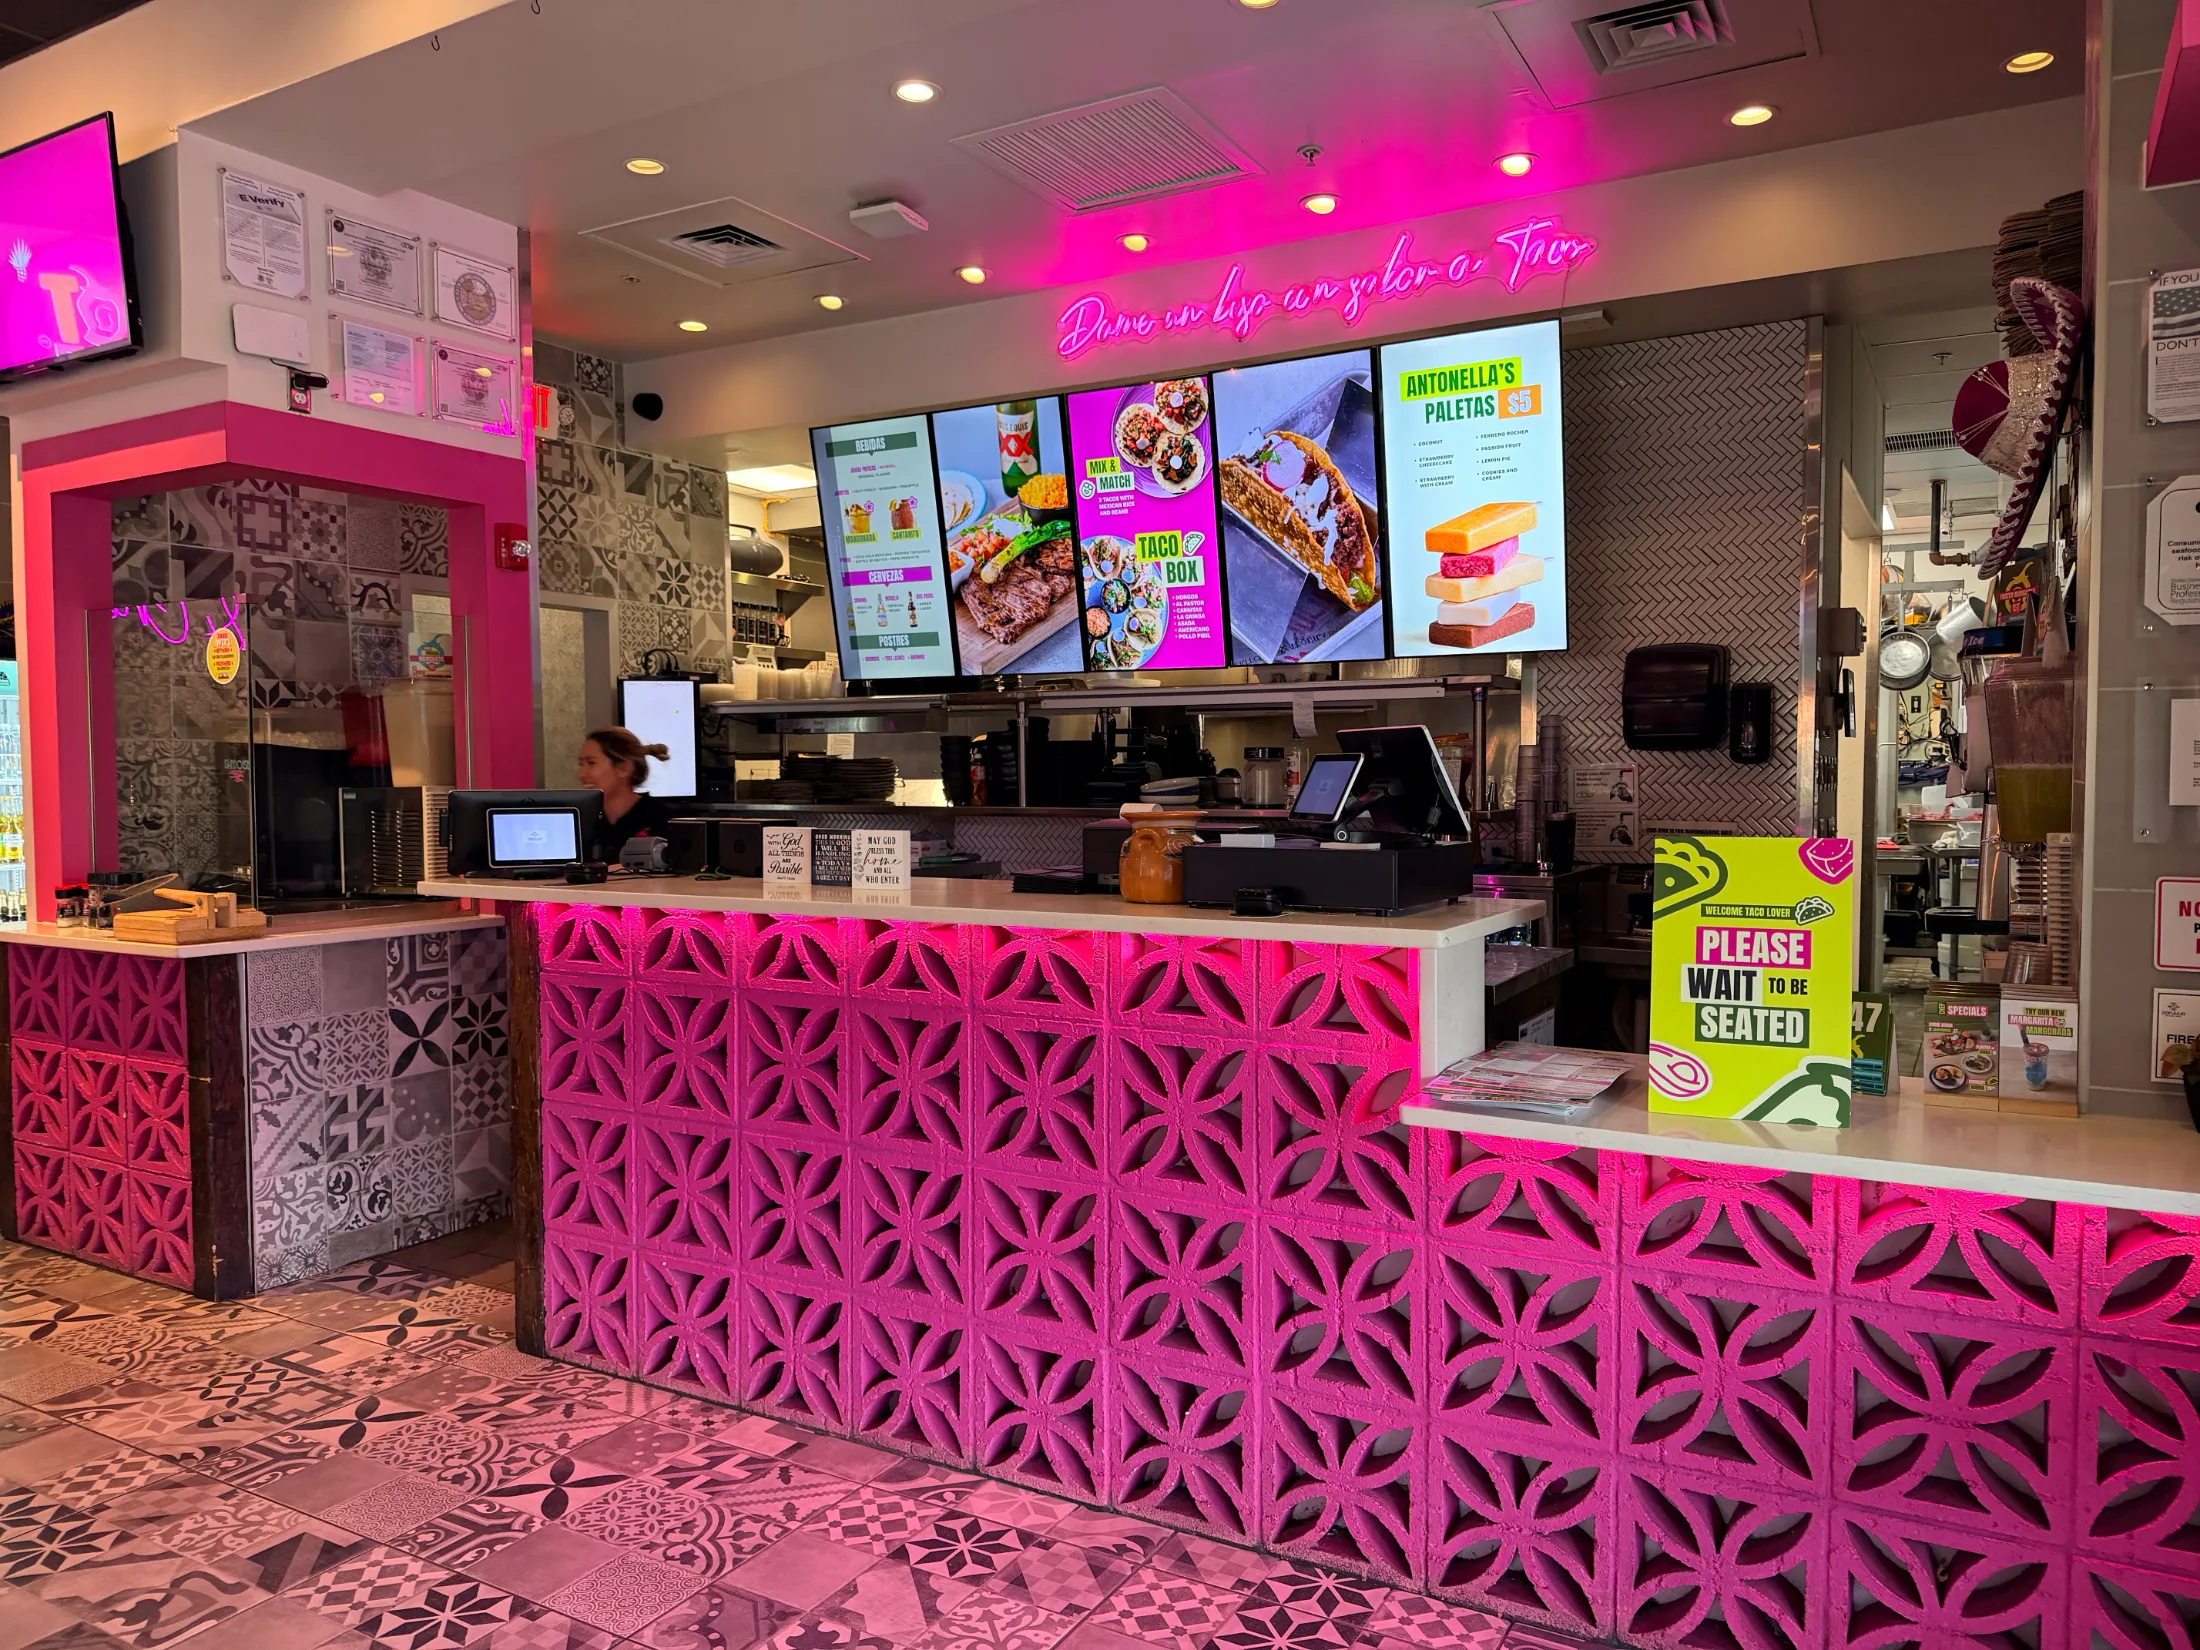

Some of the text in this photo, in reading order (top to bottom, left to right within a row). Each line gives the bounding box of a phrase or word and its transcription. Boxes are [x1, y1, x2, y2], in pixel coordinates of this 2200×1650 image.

[2158, 272, 2200, 287] IF YOU
[1406, 361, 1515, 398] ANTONELLA'S
[1425, 389, 1532, 424] PALETAS $5
[1010, 421, 1029, 432] EQUIS
[855, 437, 886, 452] BEBIDAS
[1418, 439, 1443, 447] COCONUT
[1480, 444, 1504, 452] PASSION
[1418, 454, 1454, 463] STRAWBERRY
[1418, 460, 1453, 468] CHEESECAKE
[1089, 459, 1117, 475] MIX &
[1099, 474, 1131, 491] MATCH
[1419, 475, 1455, 483] STRAWBERRY
[845, 530, 919, 543] MANGONADA CANTARITO
[1138, 534, 1179, 558] TACO
[868, 569, 904, 583] CERVEZAS
[1166, 560, 1198, 583] BOX
[879, 634, 910, 647] POSTRES
[780, 832, 803, 850] God
[867, 836, 896, 845] MAY GOD
[863, 848, 902, 867] home
[884, 847, 895, 855] THIS
[767, 860, 803, 875] Possible
[865, 876, 900, 884] WHO ENTER
[1705, 905, 1791, 918] WELCOME TACO LOVER
[1702, 930, 1805, 966] PLEASE
[1687, 967, 1808, 1002] WAIT TO BE
[1852, 1001, 1882, 1033] 47
[1947, 1005, 1987, 1017] SPECIALS
[2025, 1007, 2065, 1017] TRY OUR NEW
[1700, 1005, 1804, 1044] SEATED
[2010, 1015, 2054, 1026] MARGARITA
[2025, 1026, 2072, 1037] MANGONADA
[2166, 1034, 2196, 1045] FIRE
